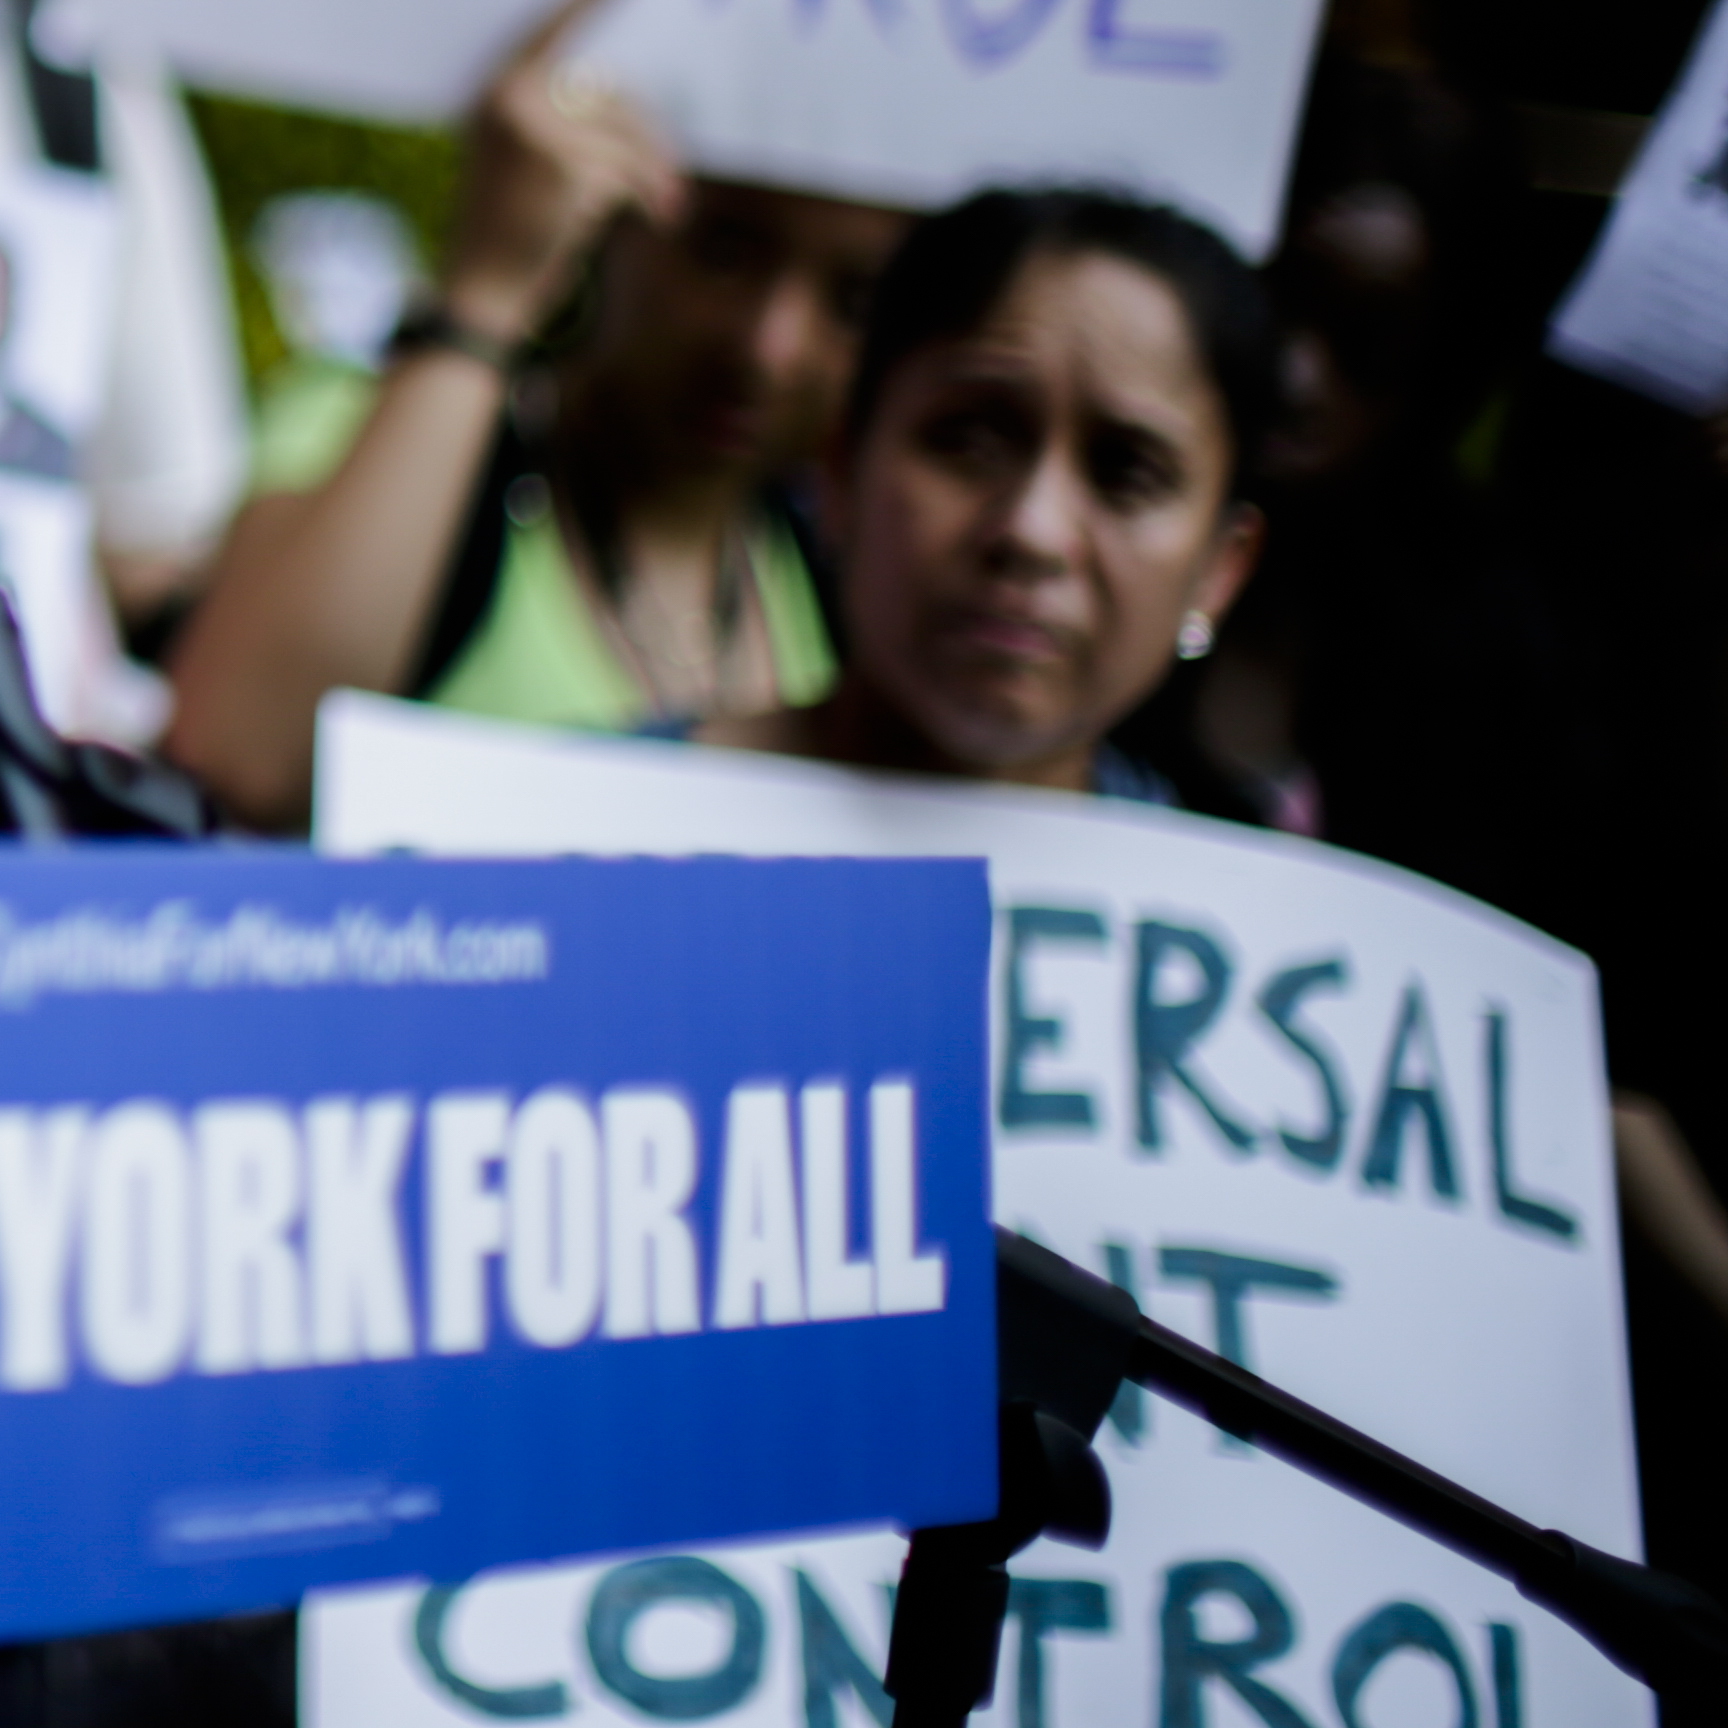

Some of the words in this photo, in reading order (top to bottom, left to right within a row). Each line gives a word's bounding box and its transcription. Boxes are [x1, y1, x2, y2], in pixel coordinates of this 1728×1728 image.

[424, 1084, 701, 1355] FOR
[712, 1077, 947, 1330] ALL
[995, 898, 1589, 1250] ERSAL
